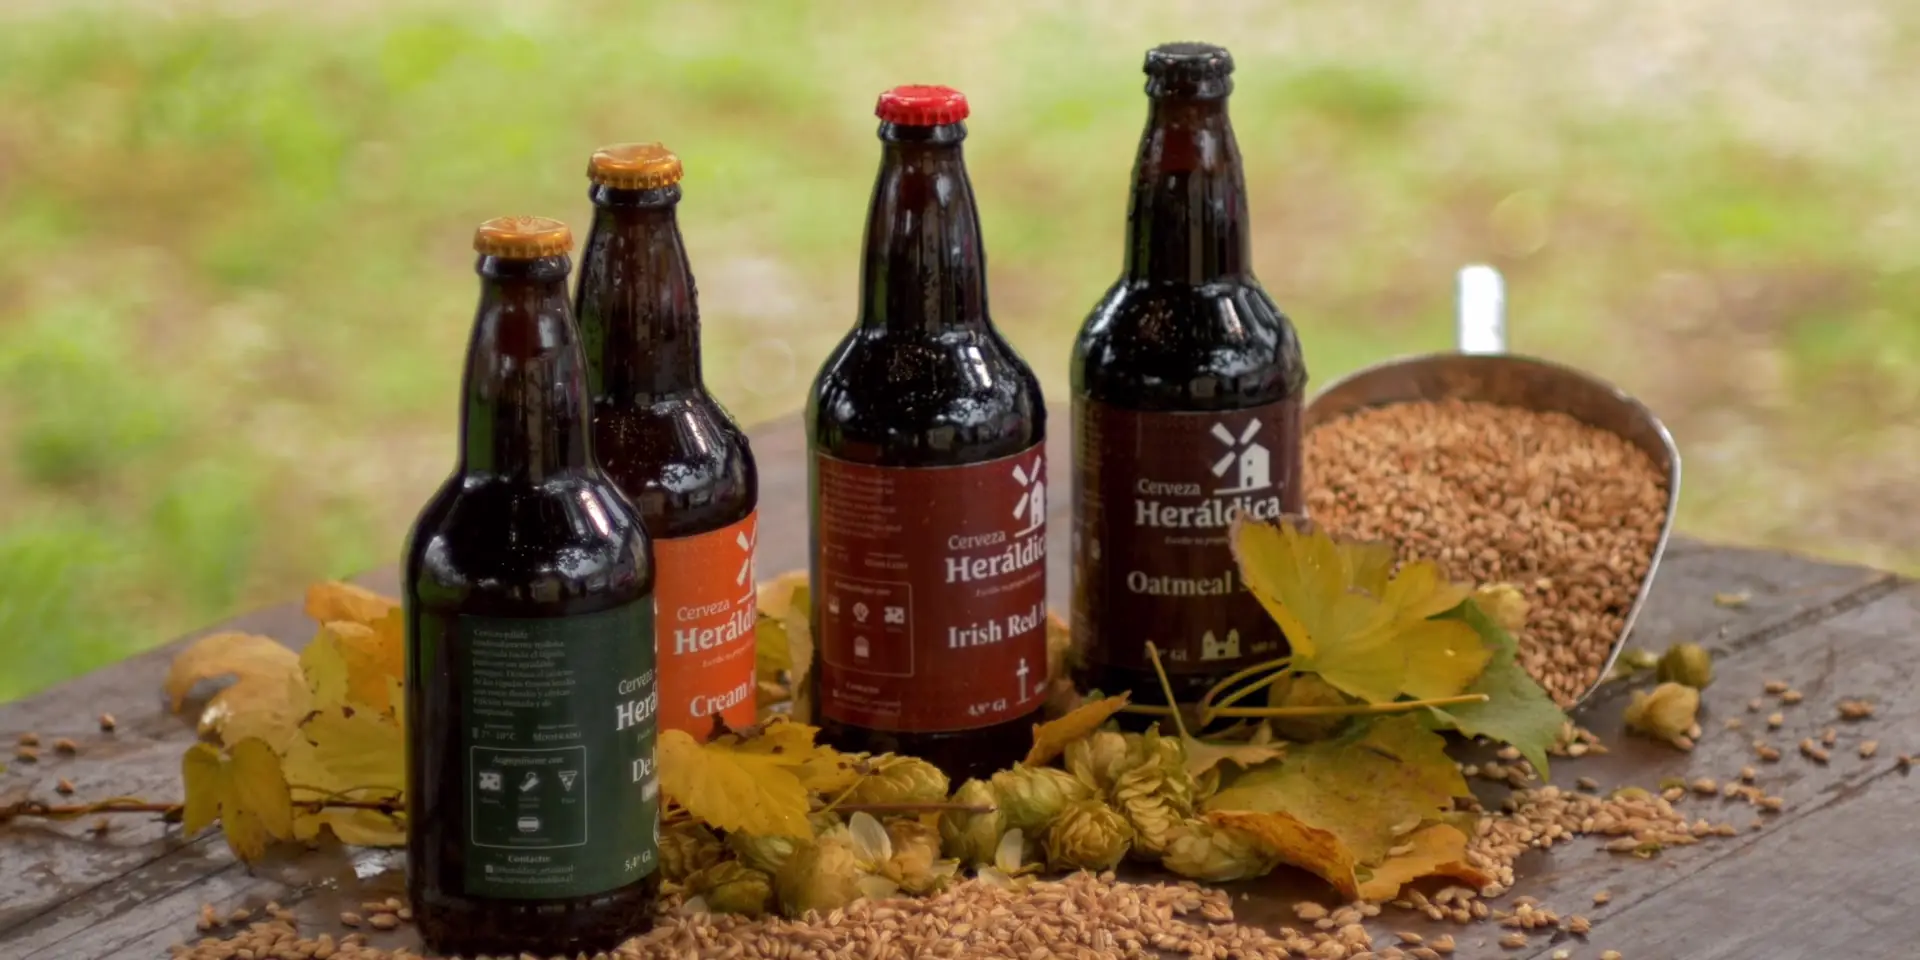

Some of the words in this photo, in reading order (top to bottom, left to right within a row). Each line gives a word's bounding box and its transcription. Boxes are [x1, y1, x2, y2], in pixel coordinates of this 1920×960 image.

[1137, 479, 1201, 496] Cerveza
[1135, 496, 1280, 528] Heráldica
[948, 530, 1006, 550] Cerveza
[945, 533, 1046, 583] Heráldic
[1126, 570, 1232, 597] Oatmeal
[677, 599, 730, 622] Cerveza
[948, 619, 1002, 648] Irish
[1008, 604, 1037, 638] Red
[690, 682, 748, 717] Cream
[632, 758, 651, 783] De
